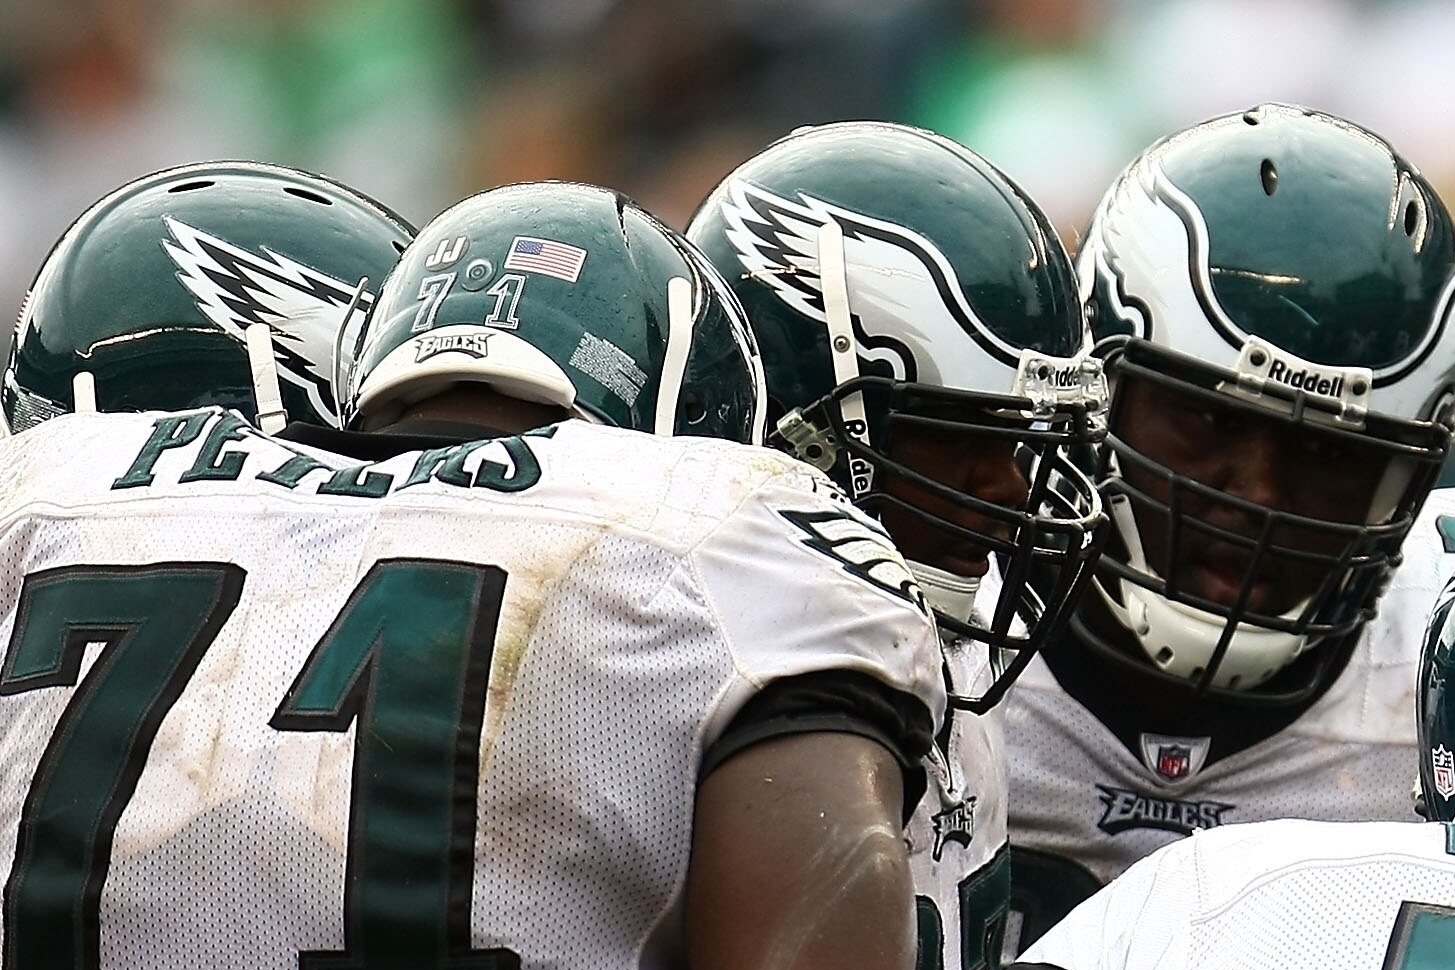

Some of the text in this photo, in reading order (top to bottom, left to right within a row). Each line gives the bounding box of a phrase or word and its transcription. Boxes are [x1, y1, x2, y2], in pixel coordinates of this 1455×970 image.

[426, 236, 468, 269] JJ
[411, 272, 527, 333] 71
[415, 331, 496, 363] EAGLES
[1268, 358, 1344, 398] Riddell
[1095, 784, 1236, 836] EAGLES
